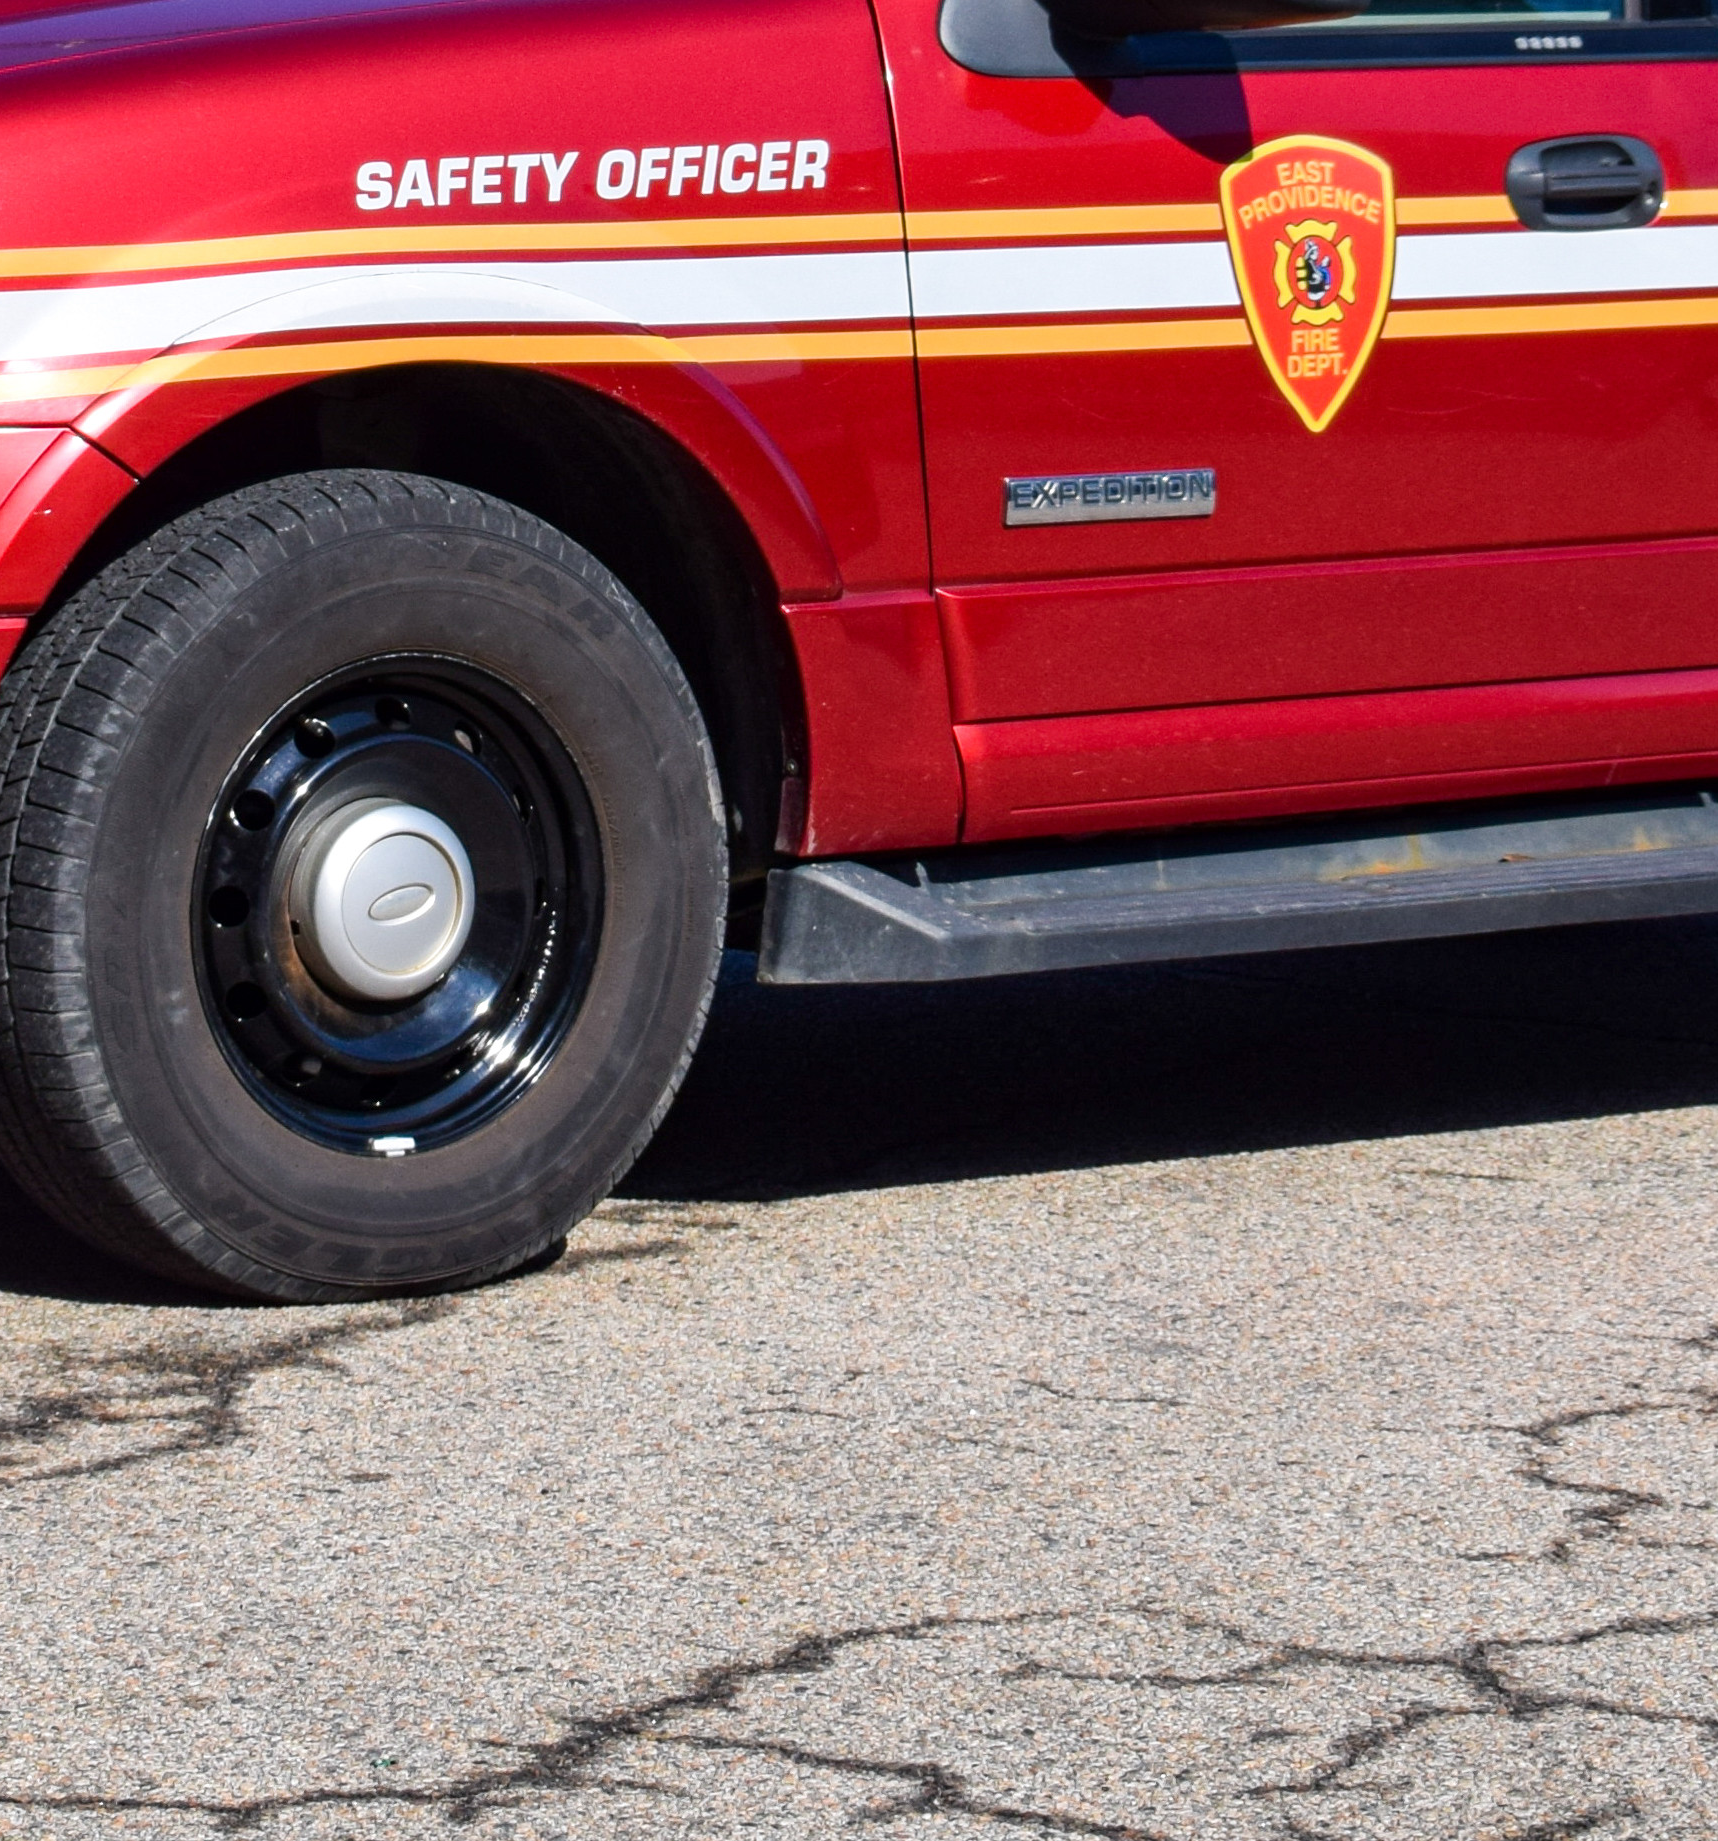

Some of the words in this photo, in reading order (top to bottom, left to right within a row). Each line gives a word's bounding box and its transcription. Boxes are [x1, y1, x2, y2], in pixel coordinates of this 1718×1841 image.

[355, 151, 579, 211] SAFETY
[596, 139, 830, 201] OFFICER
[1276, 161, 1336, 186] EAST
[1238, 185, 1382, 230] PROVIDENCE
[1291, 327, 1341, 353] FIRE
[1286, 352, 1349, 378] DEPT.
[1011, 471, 1212, 509] EXPEDITION
